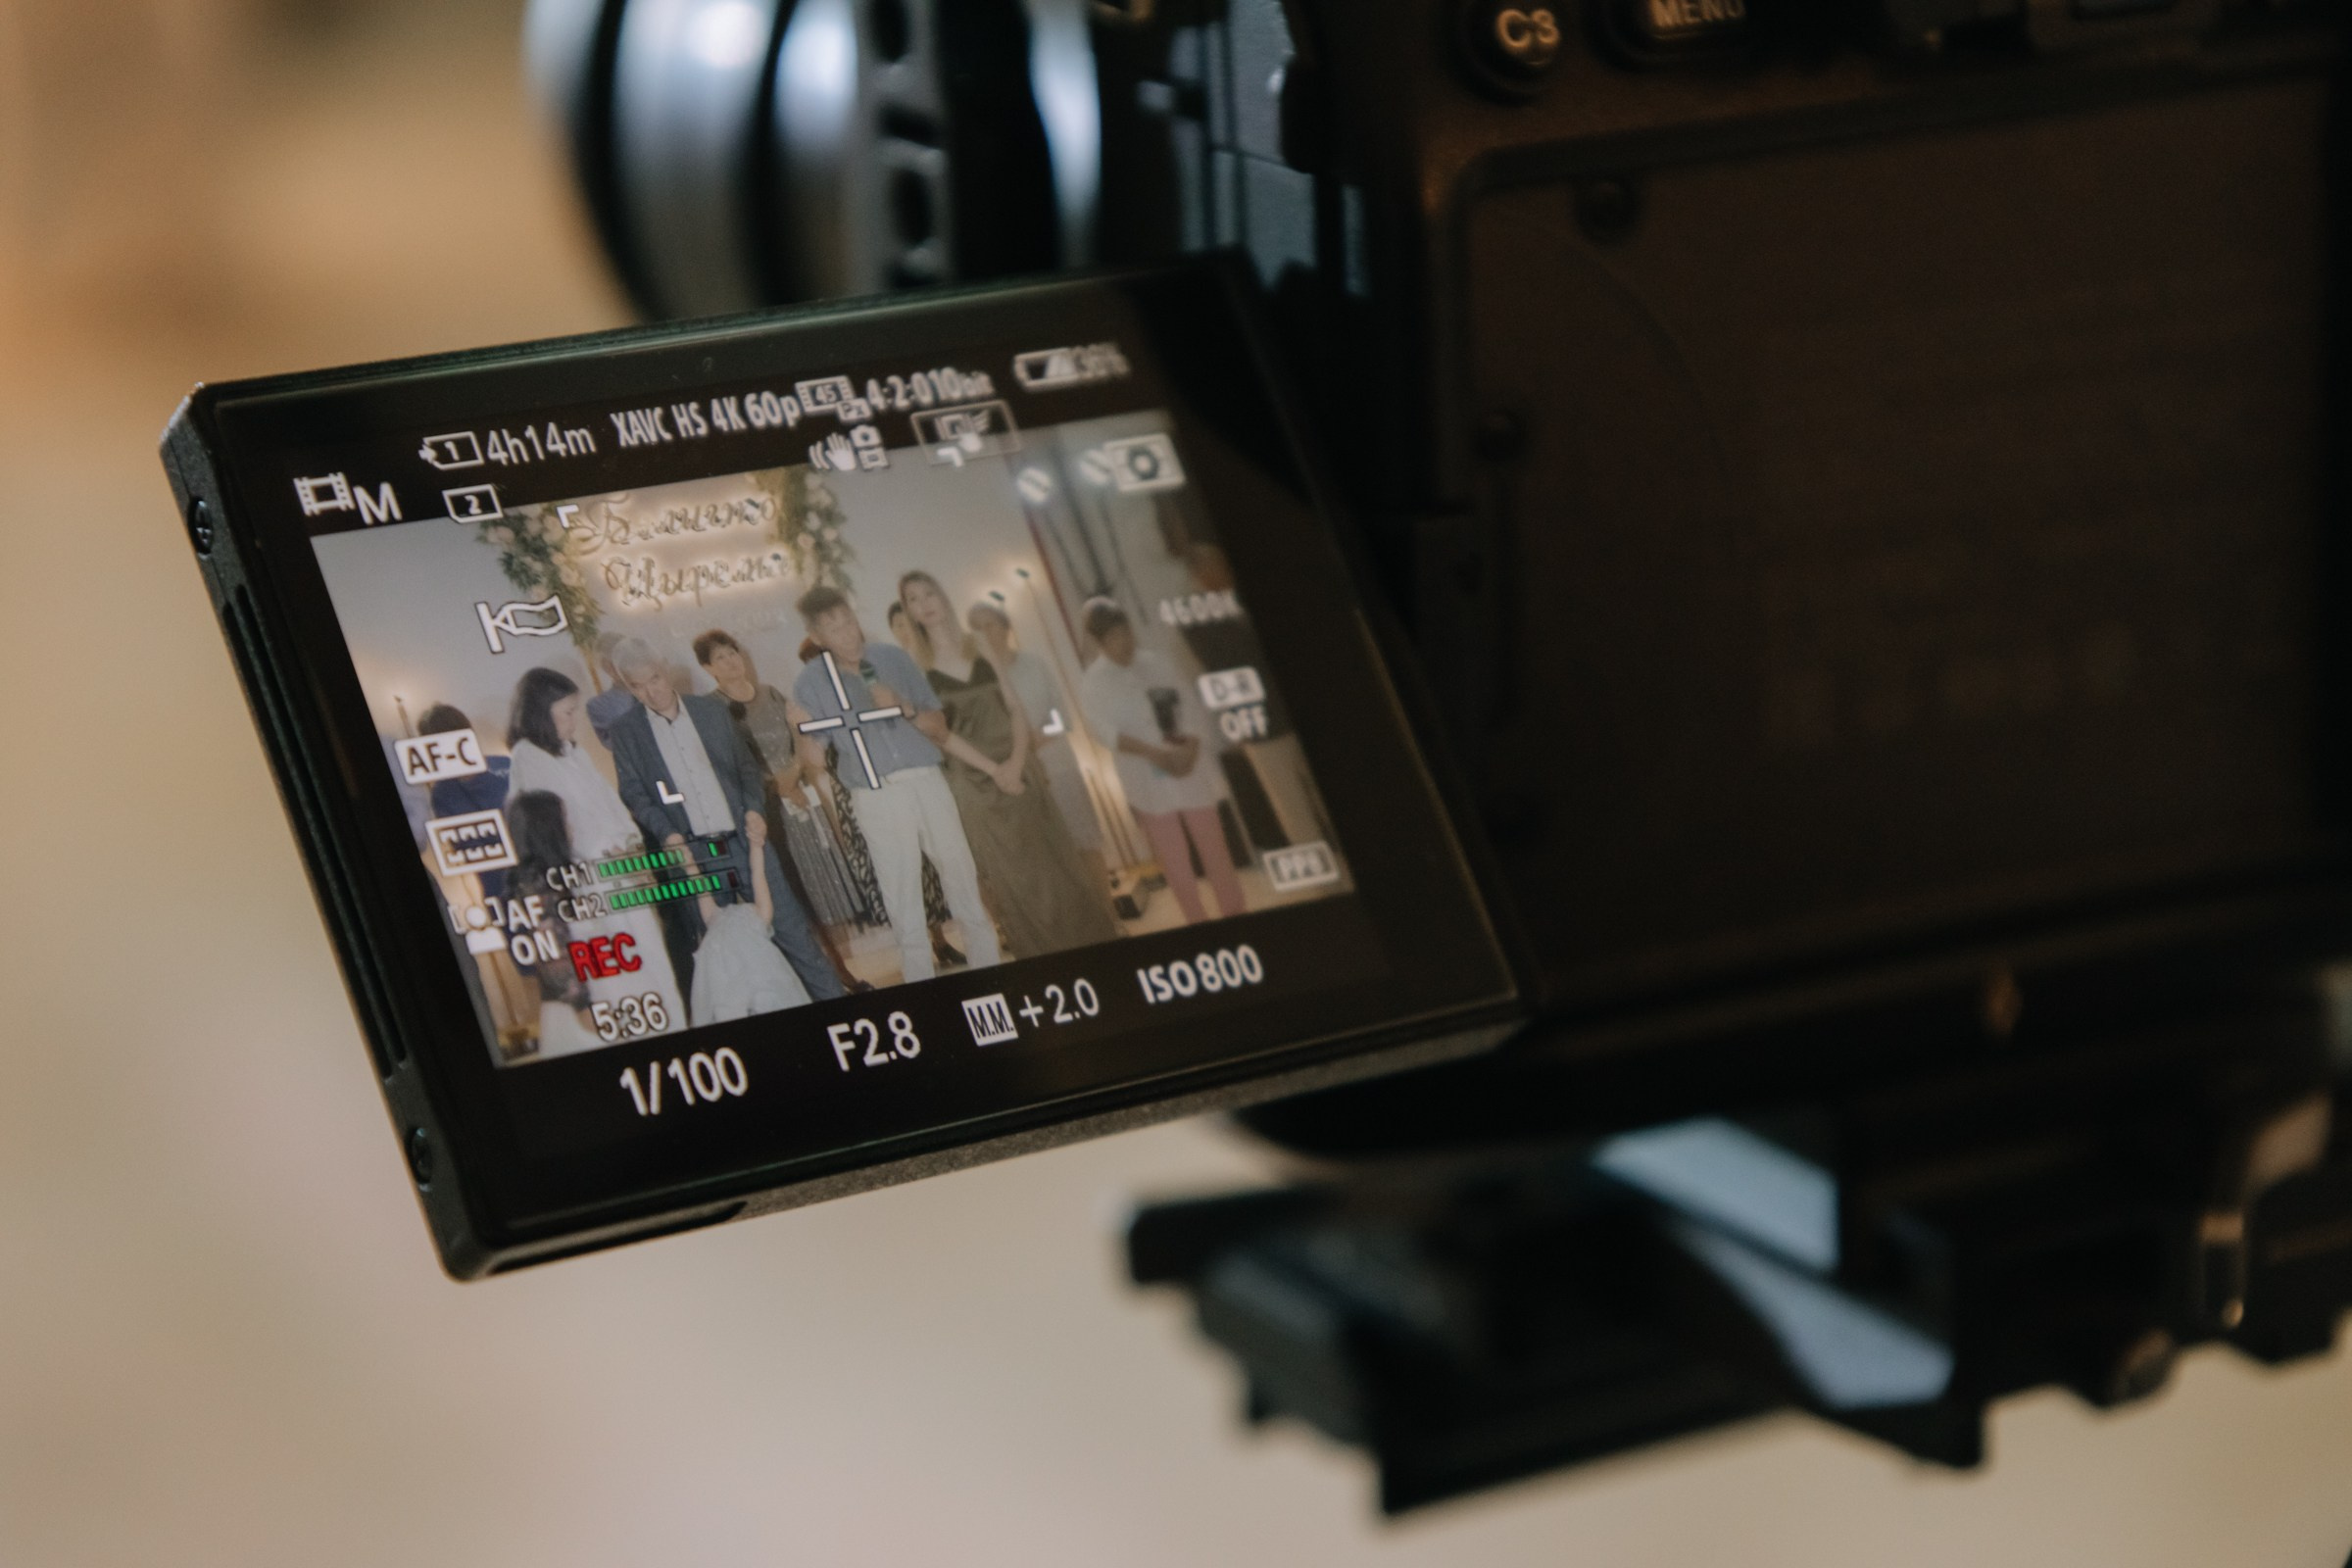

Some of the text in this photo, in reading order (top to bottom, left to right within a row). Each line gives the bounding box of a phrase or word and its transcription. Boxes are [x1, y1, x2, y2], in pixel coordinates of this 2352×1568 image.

[1495, 8, 1561, 47] C3
[1646, 0, 1747, 27] MENU
[610, 389, 799, 449] XAVC HS 4K 60p
[487, 421, 597, 466] 4h14m
[353, 481, 402, 526] M
[1220, 706, 1266, 742] OFF
[406, 735, 480, 778] AF-C
[545, 859, 595, 892] CH1
[508, 896, 544, 930] AF
[557, 892, 608, 924] CH2
[512, 930, 560, 965] ON
[568, 932, 642, 983] REC
[590, 991, 668, 1042] 5:36
[1019, 978, 1100, 1027] +2.0
[826, 1010, 921, 1071] F2.8
[619, 1047, 748, 1116] 1/100
